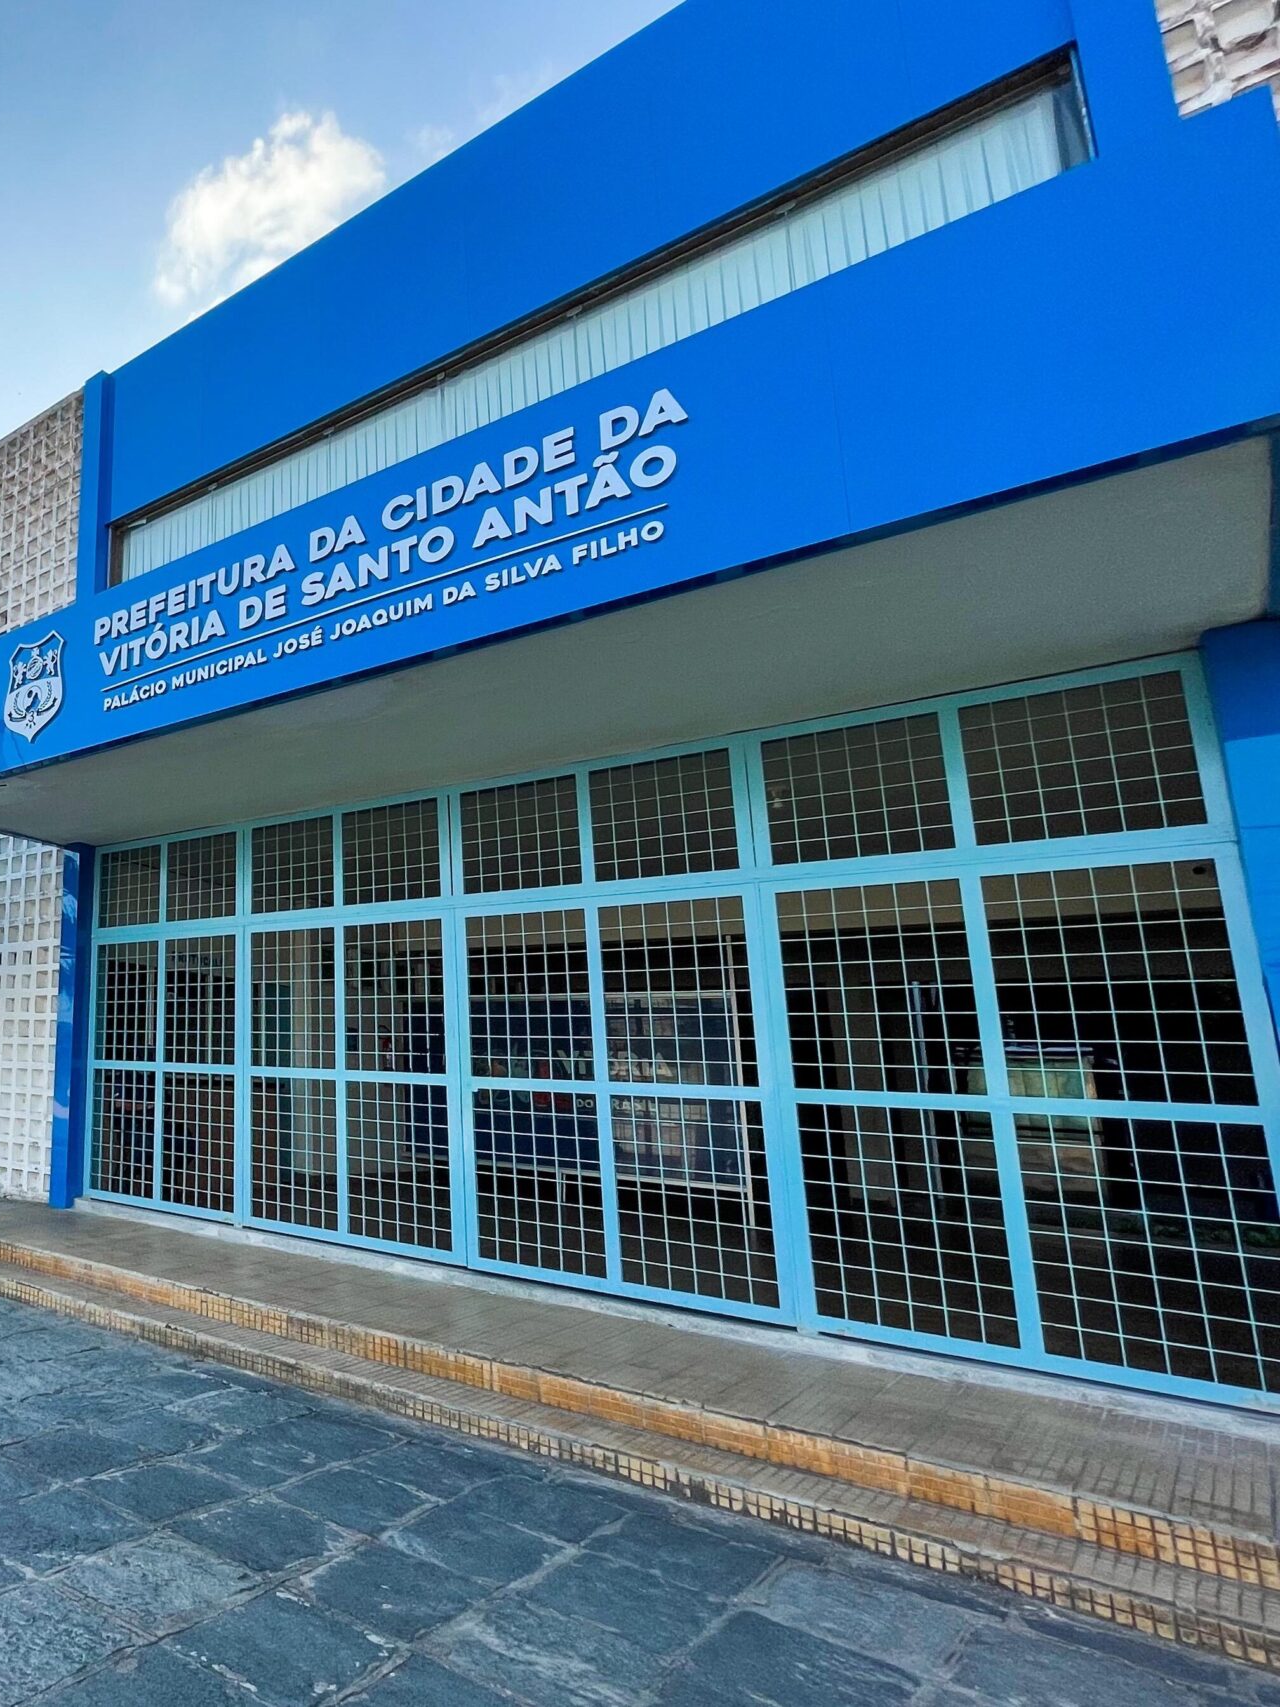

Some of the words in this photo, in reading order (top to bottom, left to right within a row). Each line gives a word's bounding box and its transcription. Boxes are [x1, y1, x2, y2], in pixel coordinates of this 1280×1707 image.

[93, 543, 296, 646] PREFEITURA
[308, 514, 366, 563] DA
[381, 426, 576, 531] CIDADE
[598, 387, 689, 451] DA
[98, 609, 226, 677] VITÓRIA
[238, 584, 288, 630] DE
[300, 526, 455, 606] SANTO
[472, 445, 678, 549] ANTÃO
[102, 678, 167, 712] PALÁCIO
[171, 648, 268, 690] MUNICIPAL
[272, 625, 324, 659] JOSÉ
[329, 593, 434, 641] JOAQUIM
[442, 581, 477, 606] DA
[484, 554, 563, 592] SILVA
[572, 520, 666, 566] FILHO
